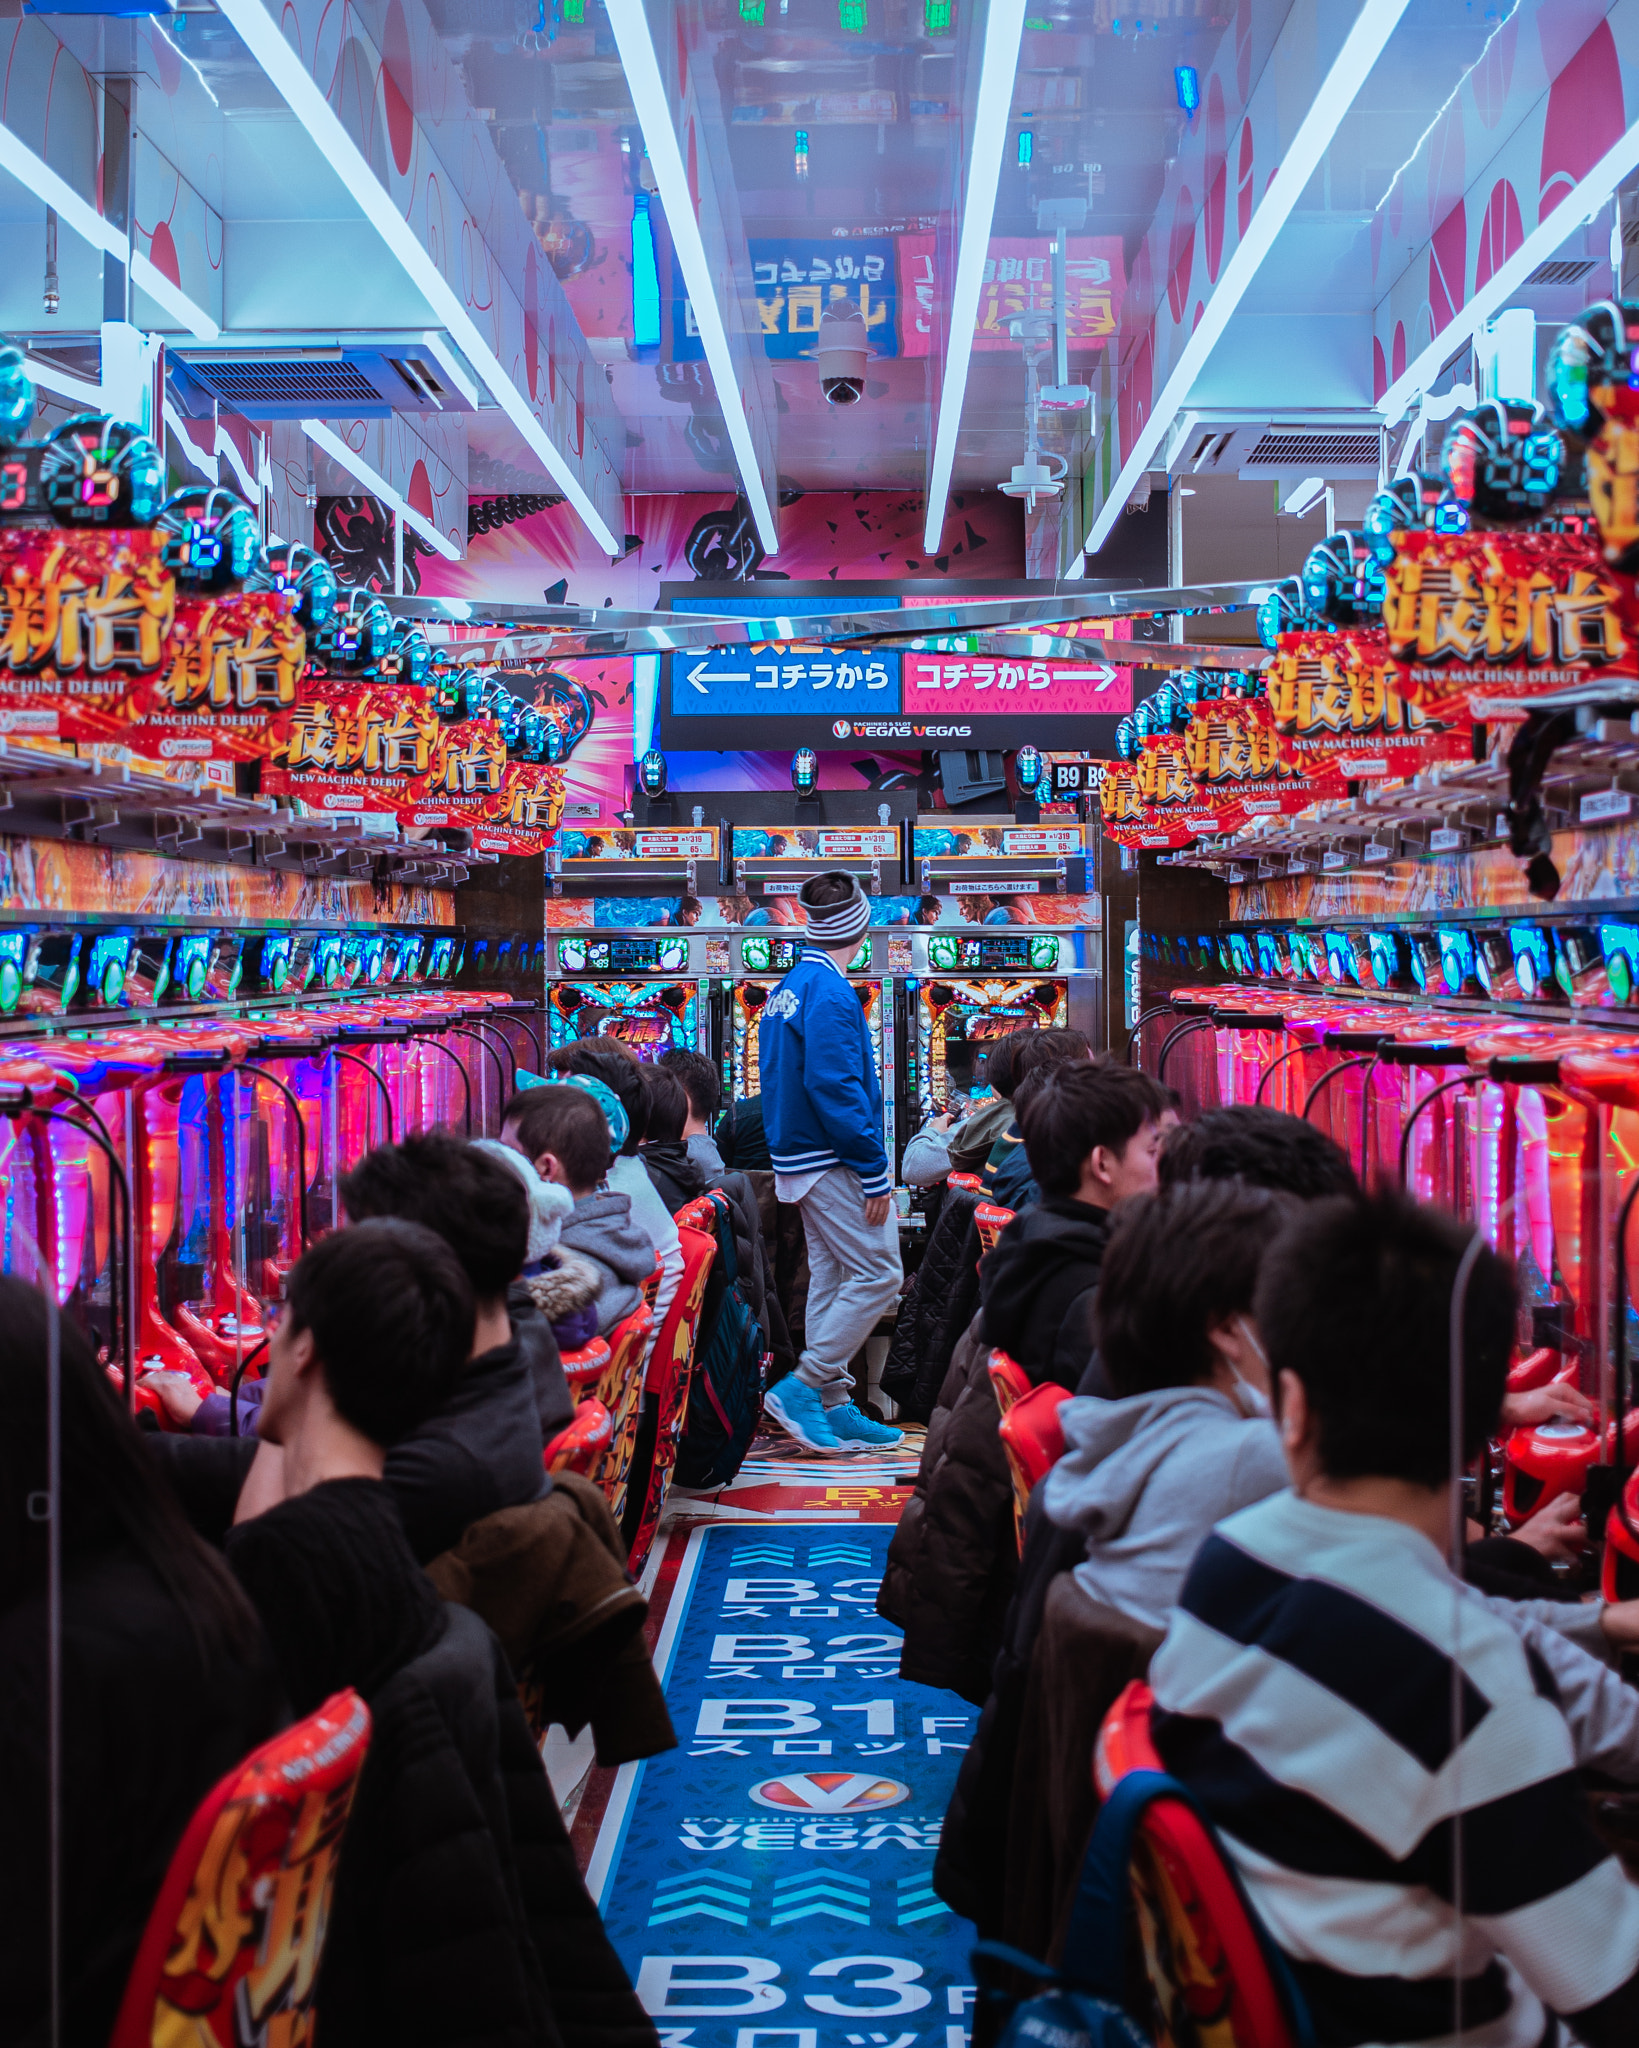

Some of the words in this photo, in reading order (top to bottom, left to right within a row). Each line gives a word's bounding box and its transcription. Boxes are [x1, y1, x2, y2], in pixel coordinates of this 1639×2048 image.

[1384, 562, 1625, 663] 最新台
[755, 662, 889, 690] コチラから
[916, 663, 1051, 690] コチラから
[1410, 670, 1448, 683] NEW
[1450, 669, 1526, 683] MACHINE
[1528, 670, 1581, 683] DEBUT
[68, 680, 127, 695] DEBUT
[1269, 656, 1440, 733] 最新
[150, 714, 217, 727] MACHINE
[220, 715, 269, 727] DEBUT
[271, 701, 438, 773] 最新台
[853, 726, 912, 737] VEGAS
[912, 726, 972, 737] VEGAS
[1185, 718, 1300, 782] 最新
[1292, 739, 1322, 750] NEW
[1324, 737, 1382, 750] MACHINE
[1384, 736, 1427, 748] DEBUT
[290, 773, 315, 783] NEW
[317, 775, 367, 786] MACHINE
[370, 778, 407, 788] DEBUT
[1057, 766, 1080, 788] B9
[1204, 786, 1228, 796] NEW
[1229, 783, 1277, 795] MACHINE
[1278, 780, 1312, 792] DEBUT
[452, 797, 483, 805] DEBUT
[1153, 807, 1173, 815] NEW
[1174, 806, 1209, 814] MACHIN
[477, 825, 513, 836] MACHINE
[514, 829, 541, 839] DEBUT
[776, 958, 794, 968] 557
[722, 1578, 884, 1602] B3
[710, 1634, 905, 1662] B2
[704, 1665, 900, 1679] スロッ
[686, 1737, 971, 1757] スロット
[683, 1816, 855, 1824] PACHINKO
